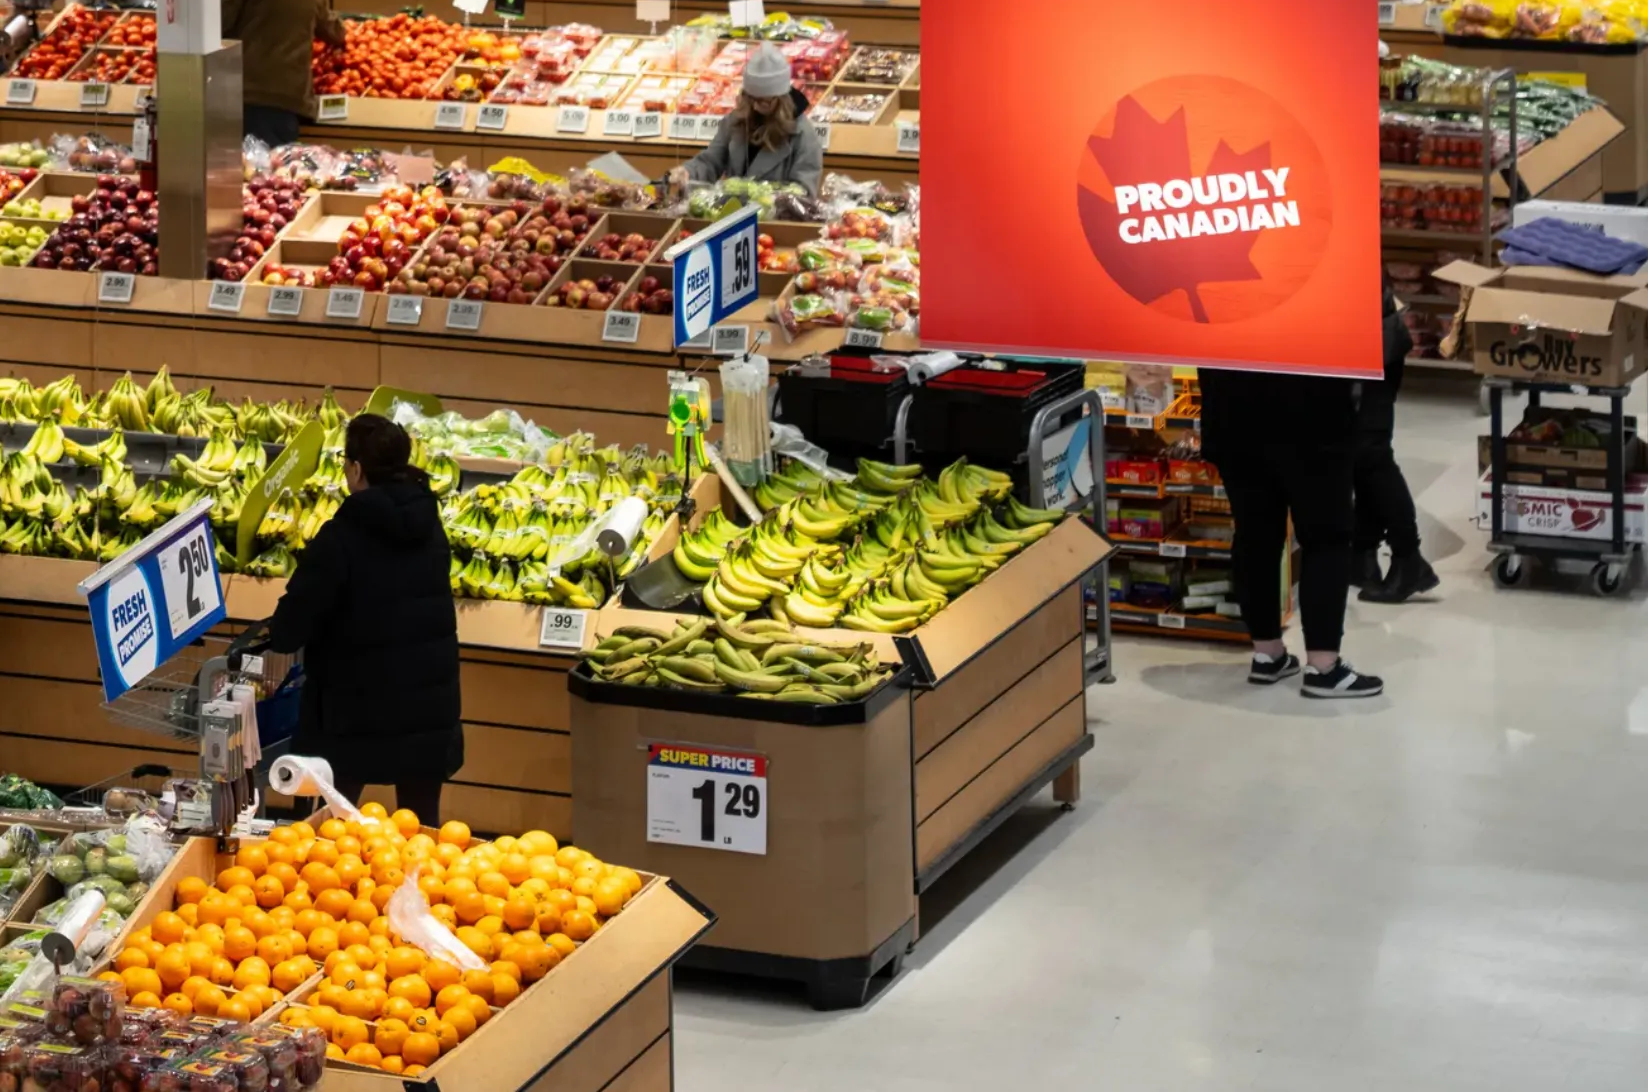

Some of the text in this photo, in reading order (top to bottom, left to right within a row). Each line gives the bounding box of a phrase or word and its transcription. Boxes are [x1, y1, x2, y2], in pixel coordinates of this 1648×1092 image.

[1114, 167, 1292, 215] PROUDLY
[1118, 199, 1301, 245] CANADIAN
[686, 266, 710, 294] FRESH
[851, 333, 878, 347] 8.99
[263, 445, 308, 501] Organic
[1043, 449, 1069, 470] ersonal
[112, 589, 148, 632] FRESH
[120, 618, 153, 663] PROMISE
[660, 749, 756, 772] SUPER PRICE
